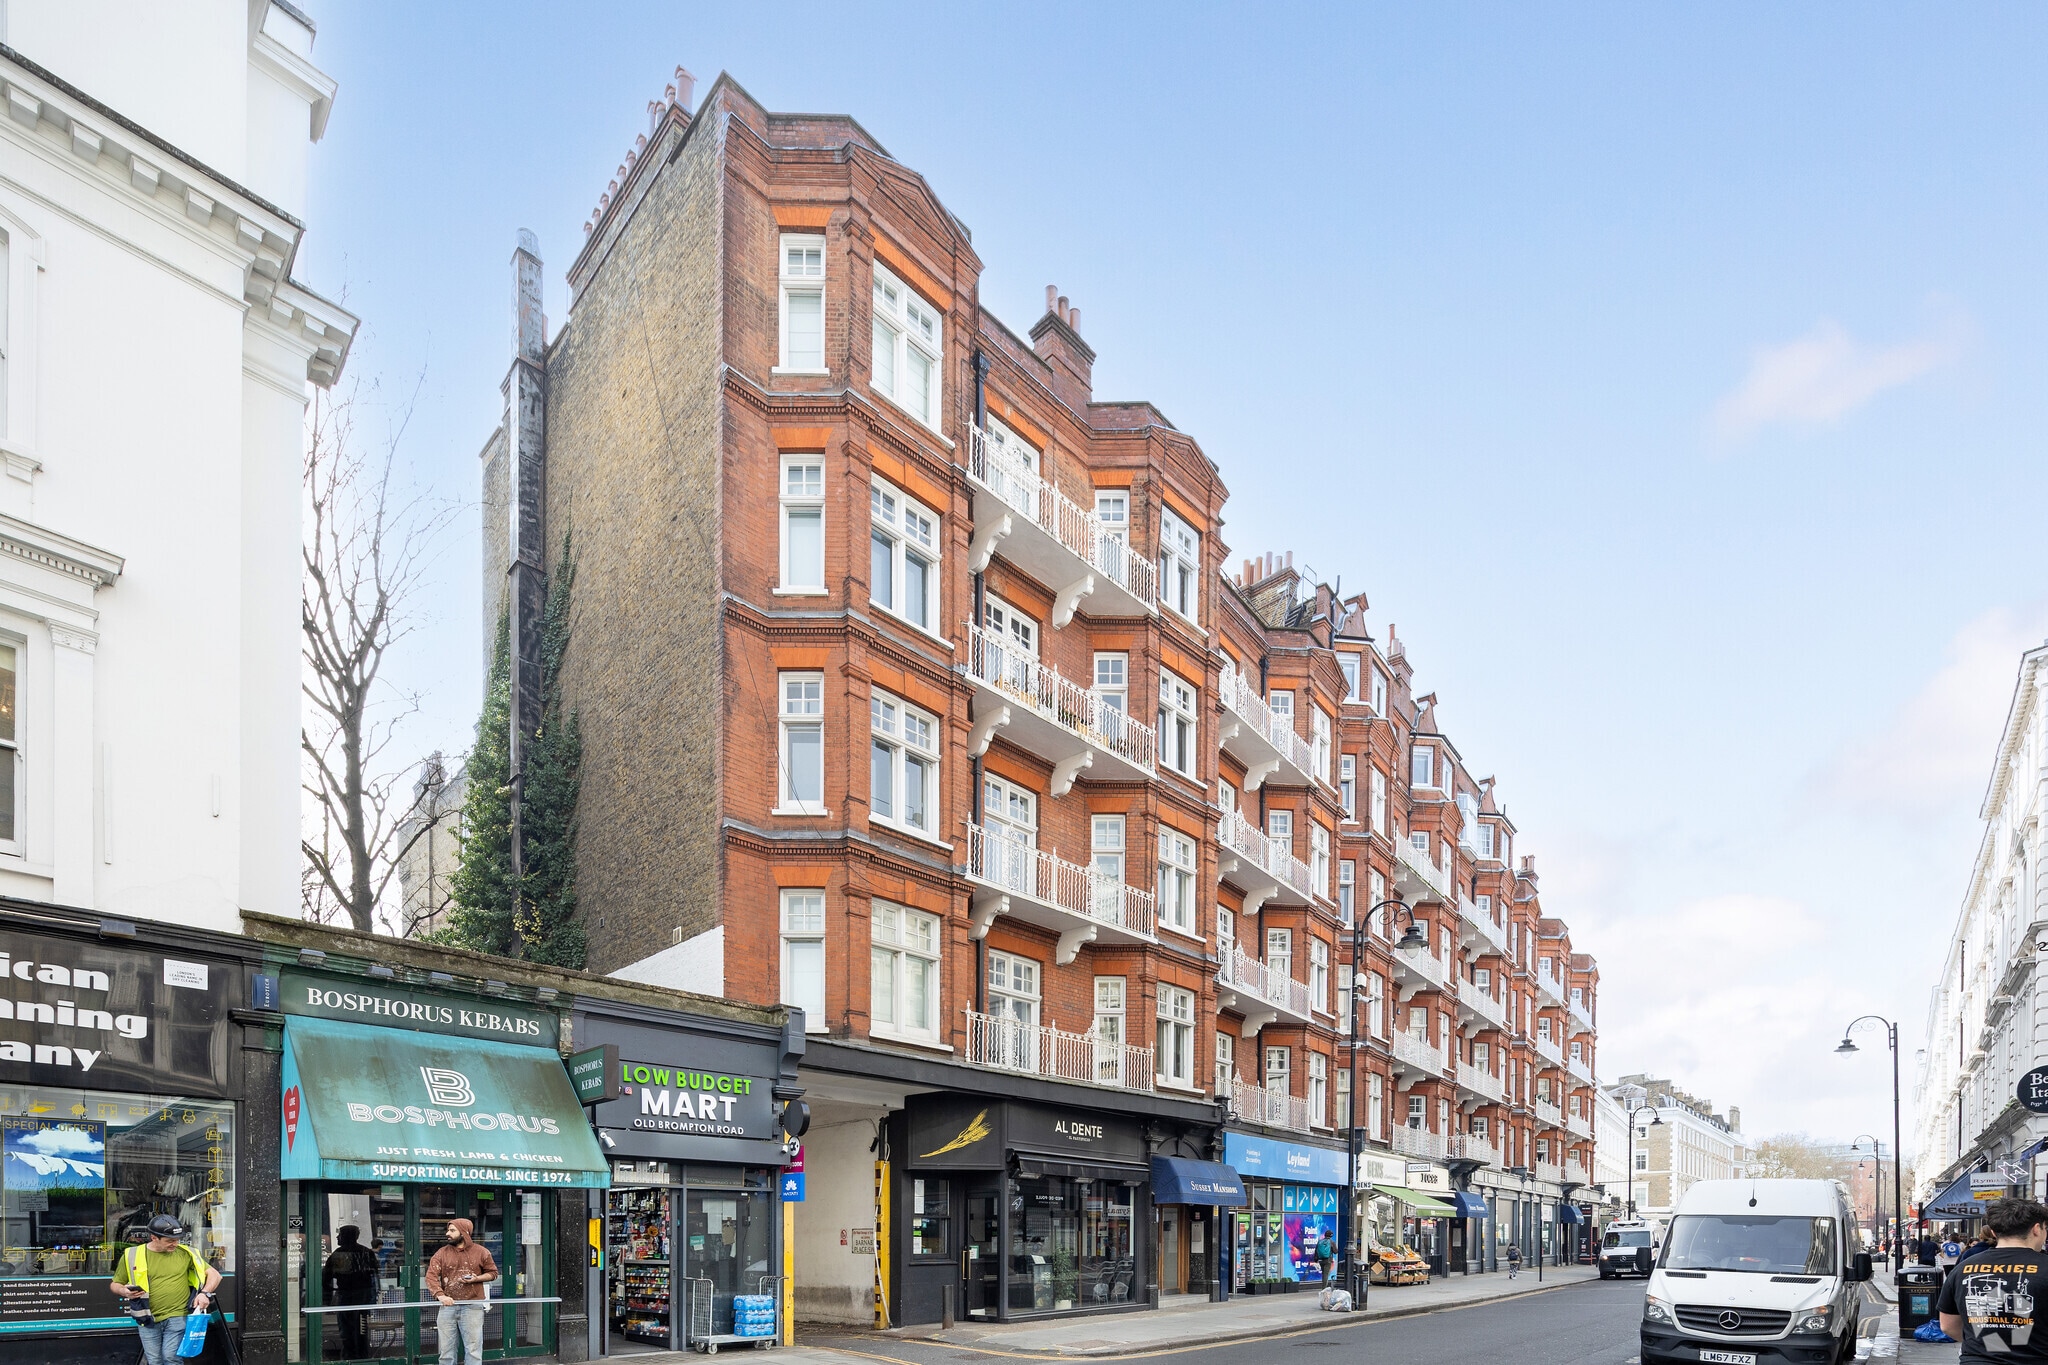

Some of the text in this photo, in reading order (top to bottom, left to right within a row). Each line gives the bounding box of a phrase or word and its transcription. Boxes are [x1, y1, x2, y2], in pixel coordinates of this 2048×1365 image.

[307, 987, 540, 1036] BOSPHORUS KEBABS
[0, 1040, 101, 1072] any
[574, 1059, 603, 1075] BOSPHORUS
[420, 1066, 475, 1107] B
[581, 1076, 602, 1090] KEBABS
[623, 1064, 752, 1095] LOW BUDGET
[641, 1087, 737, 1122] MART
[5, 1120, 98, 1133] SPECIAL OFFER!
[347, 1102, 560, 1135] BOSPHORUS
[634, 1118, 744, 1135] OLD BROMPTON ROAD
[1055, 1120, 1103, 1138] AL DENTE
[376, 1146, 563, 1163] JUST FRESH LAMB & CHICKEN
[1287, 1150, 1311, 1168] Leyland
[372, 1164, 572, 1183] SUPPORTING LOCAL SINCE 1974
[1367, 1160, 1384, 1179] BENS
[1190, 1181, 1238, 1194] SUSSEX MANSIONS
[1304, 1226, 1318, 1235] Paint
[1963, 1264, 2038, 1274] DICKIES
[1968, 1316, 2034, 1326] INDUSTRIAL ZONE
[1703, 1352, 1751, 1364] LM67 FXZ
